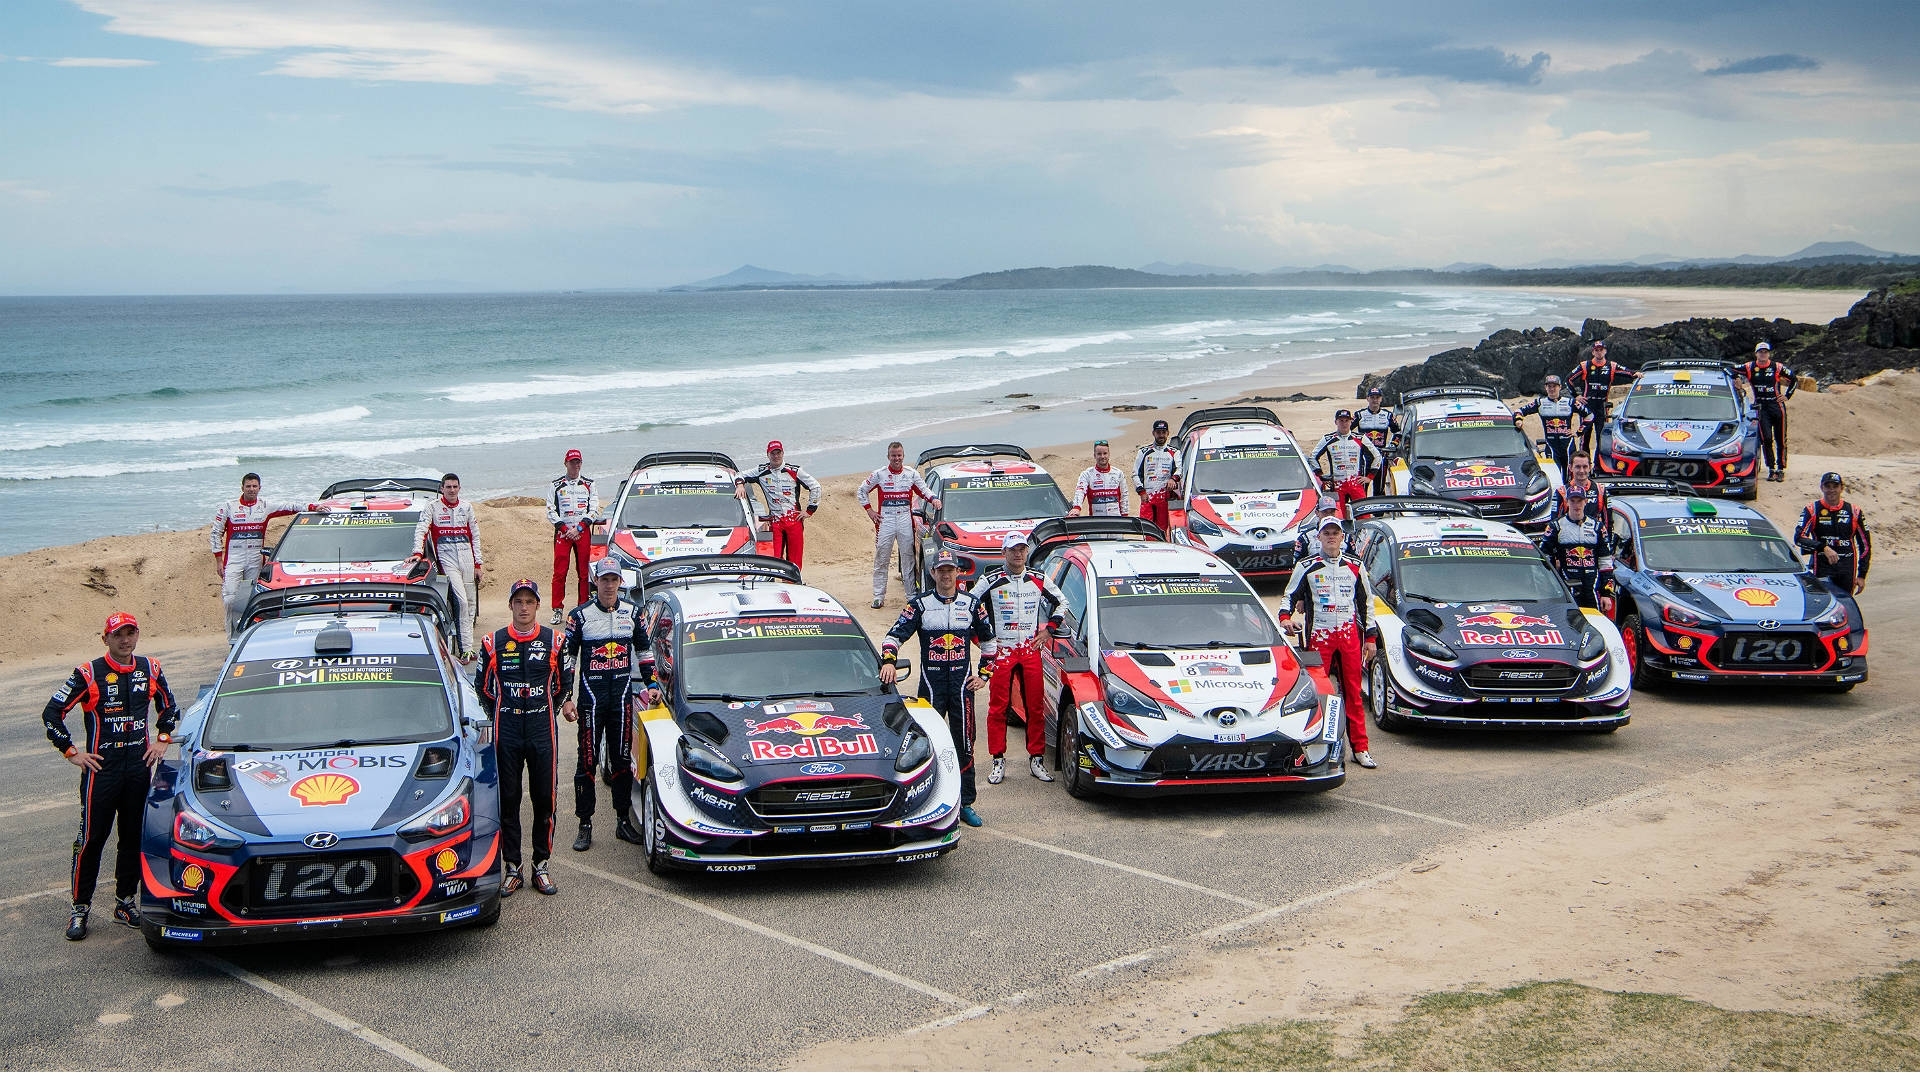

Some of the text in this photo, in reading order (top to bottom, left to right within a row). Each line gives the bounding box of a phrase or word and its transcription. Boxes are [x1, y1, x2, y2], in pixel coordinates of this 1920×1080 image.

[1437, 421, 1460, 429] PMI
[967, 480, 993, 488] PMI
[1445, 475, 1516, 488] Red Bull
[654, 487, 680, 495] PMI
[318, 516, 350, 526] PMI
[1675, 524, 1706, 534] PMI
[665, 546, 714, 554] Microsoft
[1428, 546, 1462, 556] PMI
[1441, 541, 1535, 550] PERFORMANCE
[1462, 549, 1510, 557] INSURANCE
[709, 564, 786, 575] EcoBoost
[1727, 577, 1798, 588] MOBIS
[1009, 590, 1037, 599] Microsoft
[1130, 583, 1168, 595] PMI
[1169, 585, 1220, 594] INSURANCE
[325, 592, 404, 600] HYUNDAI
[694, 617, 853, 630] FORD PERFORMANCE
[688, 632, 696, 642] 1
[721, 625, 763, 639] PMI
[765, 628, 823, 636] INSURANCE
[1460, 629, 1516, 646] Red
[1517, 629, 1566, 645] Bull
[1508, 649, 1532, 658] Ford
[1732, 637, 1803, 662] i20
[928, 650, 966, 661] Red Bull
[308, 656, 398, 668] HYUNDAI
[589, 656, 629, 671] Red Bull
[233, 664, 246, 677] 5
[1186, 667, 1198, 676] 8
[278, 668, 325, 686] PMI
[328, 672, 393, 682] INSURANCE
[1195, 679, 1265, 691] Microsoft
[510, 685, 544, 698] MOBIS
[104, 715, 135, 723] HYUNDAI
[1325, 699, 1339, 740] Panasonic
[112, 718, 146, 733] MOBIS
[1085, 705, 1121, 748] Panasonic
[1219, 734, 1241, 742] A-6113
[749, 733, 879, 761] Red Bull
[271, 750, 354, 762] HYUNDAI
[297, 755, 407, 772] MOBIS
[808, 763, 838, 774] Ford
[697, 789, 737, 811] MS-RT
[912, 807, 945, 824] MICHELIN
[896, 850, 939, 863] AZIONE
[706, 864, 756, 872] AZIONE
[263, 859, 377, 901] i20
[446, 881, 468, 896] WIA
[182, 901, 207, 909] HYUNDAI
[183, 907, 201, 915] STEEL
[452, 907, 478, 918] MICHELIN
